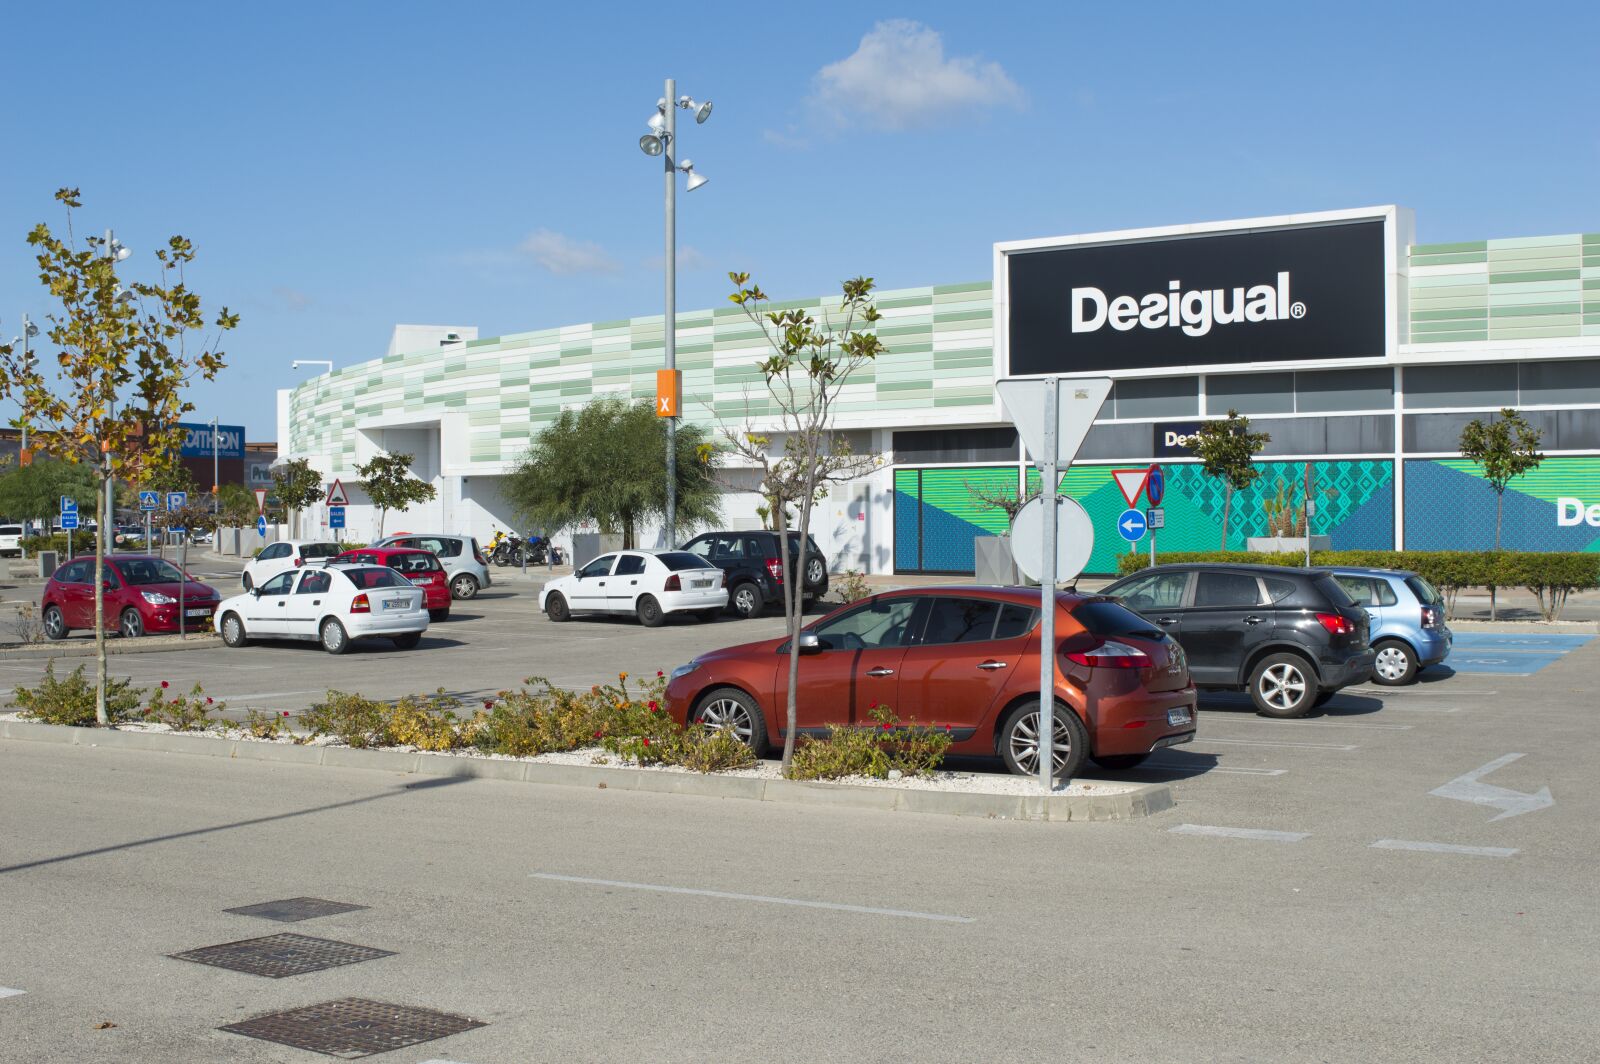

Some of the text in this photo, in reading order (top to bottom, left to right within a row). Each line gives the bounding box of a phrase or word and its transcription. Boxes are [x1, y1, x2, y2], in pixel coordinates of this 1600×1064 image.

[660, 397, 670, 412] X
[64, 498, 75, 510] P
[171, 495, 183, 511] P
